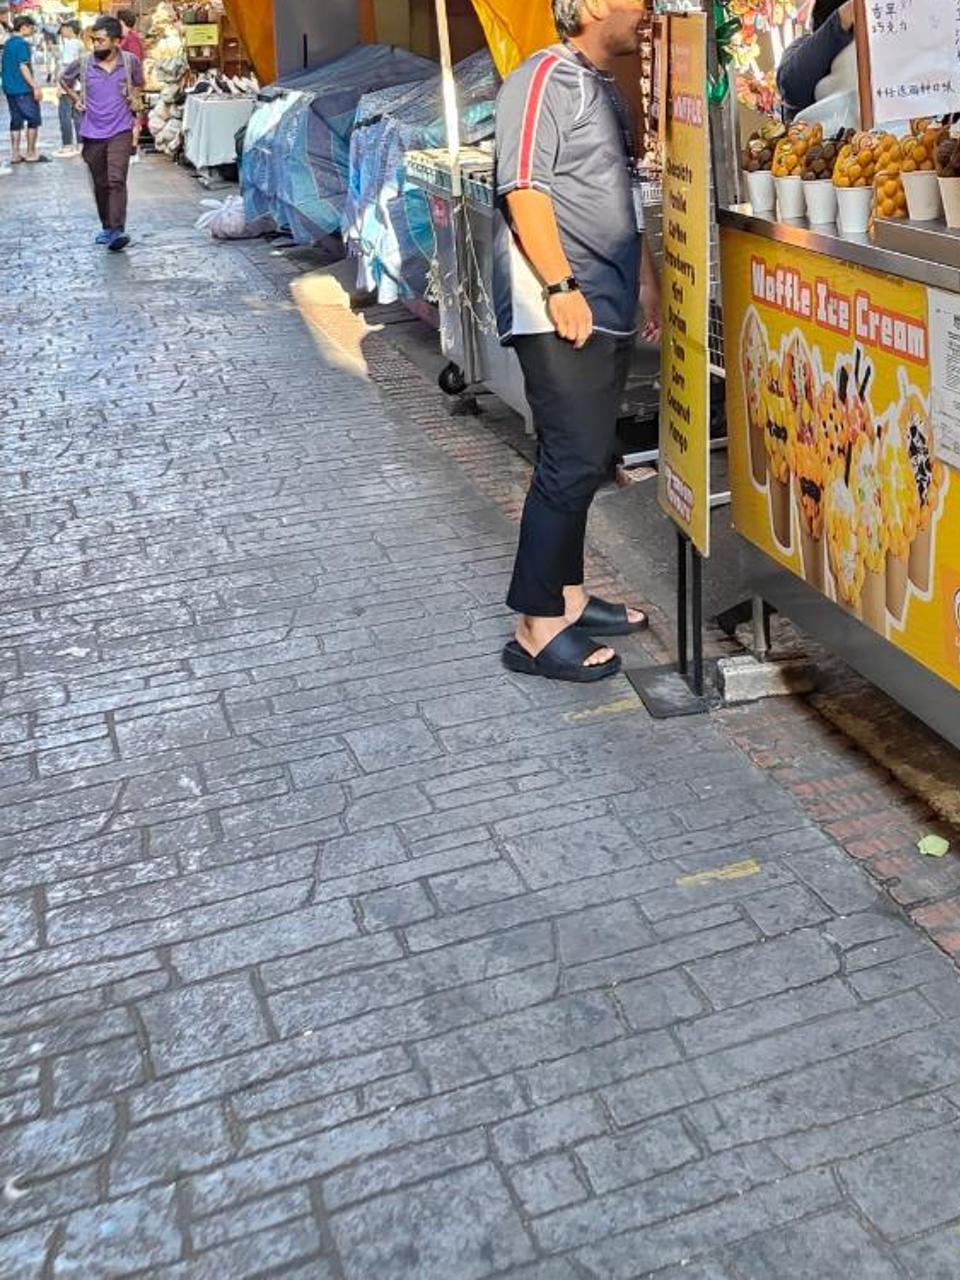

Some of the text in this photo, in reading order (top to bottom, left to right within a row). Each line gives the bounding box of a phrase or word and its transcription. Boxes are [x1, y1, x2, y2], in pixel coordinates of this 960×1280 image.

[751, 258, 812, 318] Waffle
[816, 281, 850, 332] Ice
[856, 294, 926, 360] Cream
